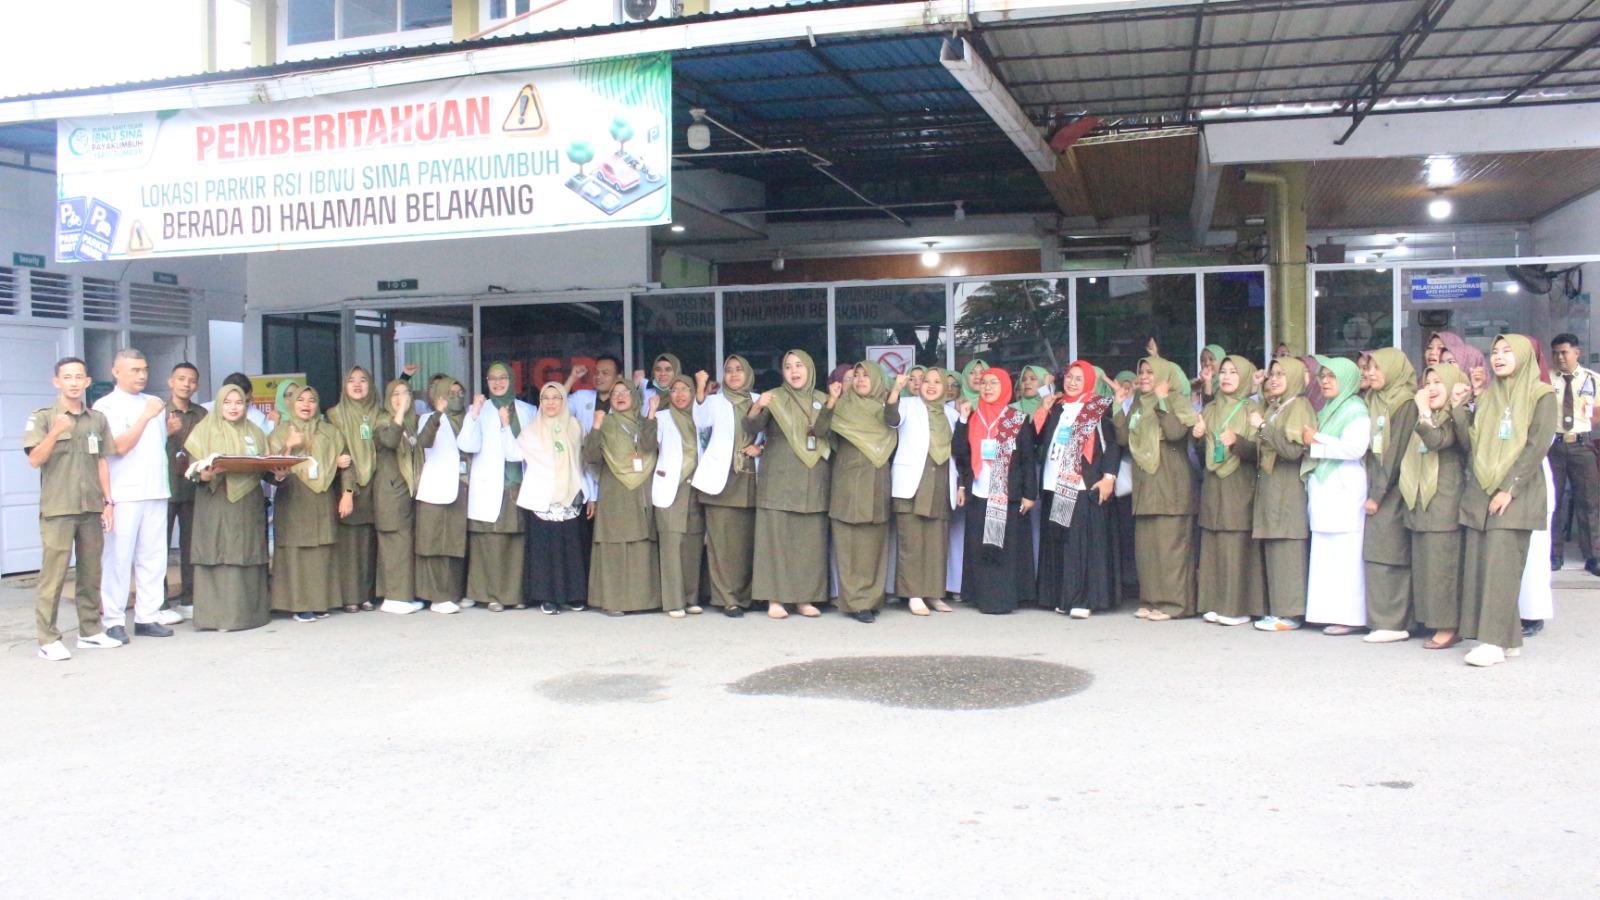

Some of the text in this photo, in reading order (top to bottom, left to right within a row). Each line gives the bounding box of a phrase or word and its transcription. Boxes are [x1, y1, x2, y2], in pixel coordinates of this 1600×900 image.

[91, 140, 144, 150] PAYAKUMBUH
[92, 129, 143, 143] IBNU SINA
[195, 96, 491, 162] PEMBERITAHUAN
[141, 149, 560, 208] LOKASI PARKIR RSI IBNU SINA PAYAKUMBUH
[162, 184, 534, 240] BERADA DI HALAMAN BELAKANG
[19, 254, 40, 267] Security
